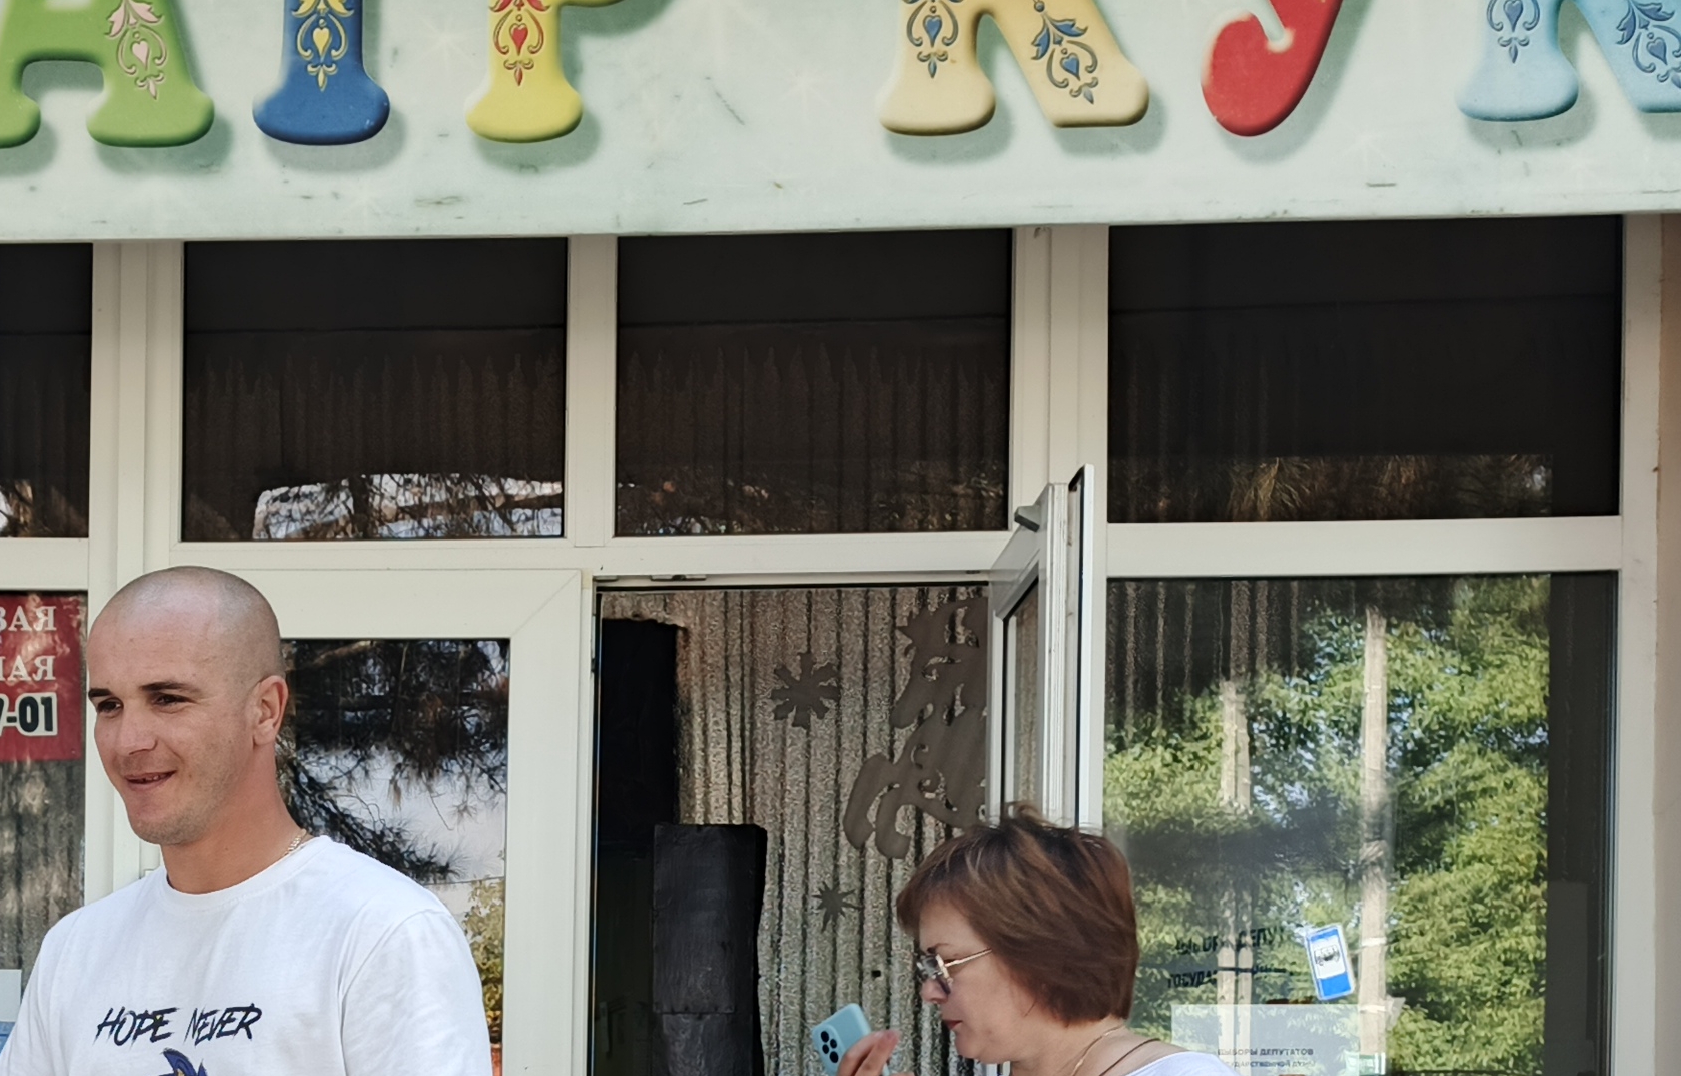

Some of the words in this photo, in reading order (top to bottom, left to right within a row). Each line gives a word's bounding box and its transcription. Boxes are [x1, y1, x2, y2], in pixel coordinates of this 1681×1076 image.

[93, 1006, 179, 1047] HOPE
[184, 1003, 263, 1047] NEVER
[1218, 1047, 1258, 1056] ВЫБОРЫ
[1259, 1047, 1314, 1056] ДЕПУТАТОВ
